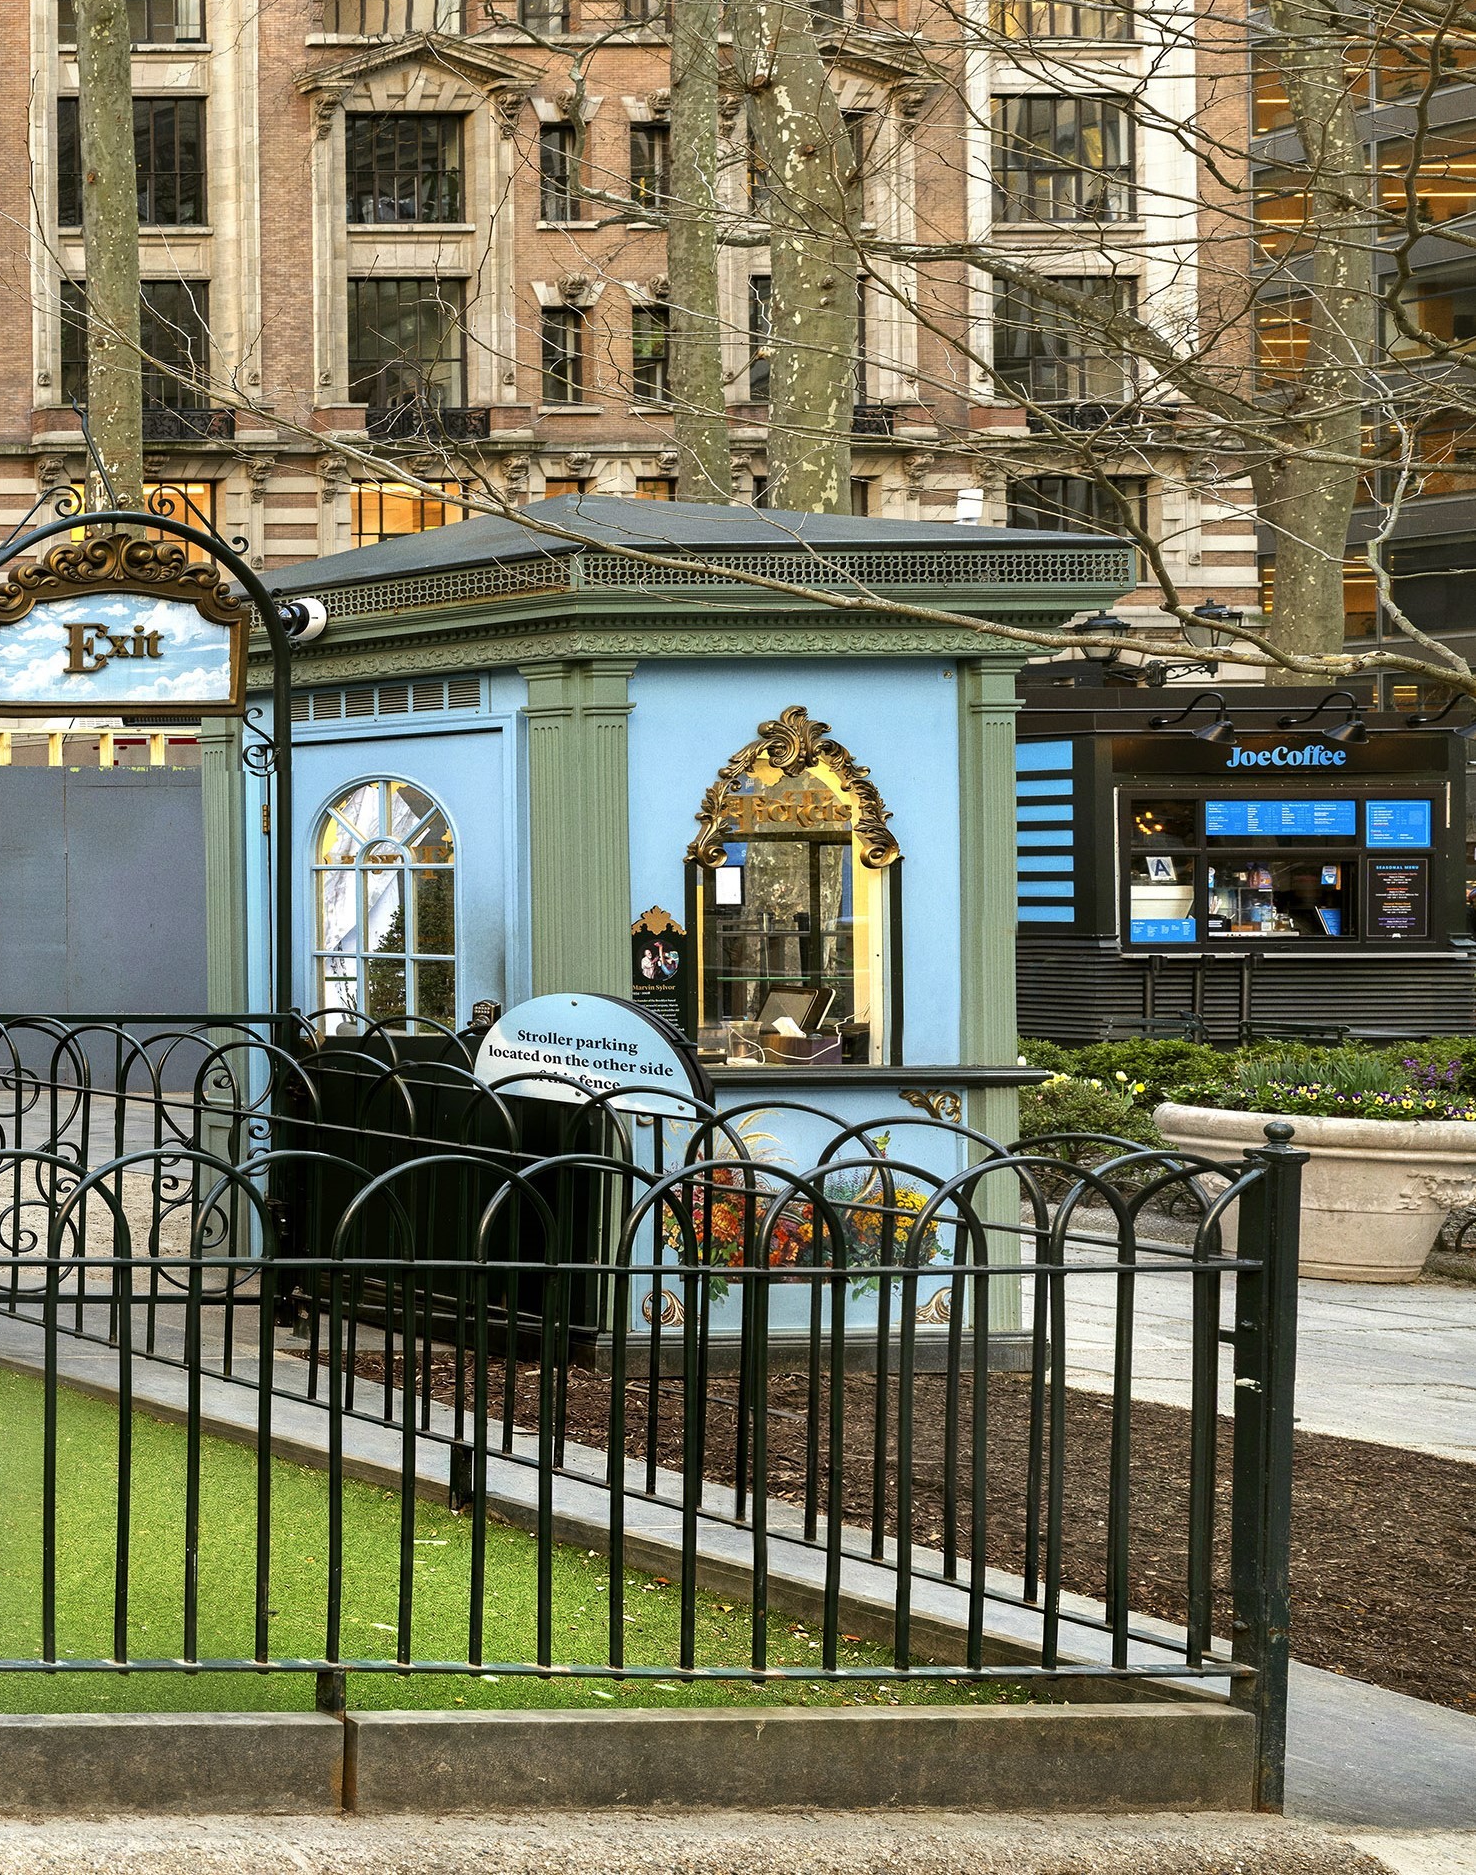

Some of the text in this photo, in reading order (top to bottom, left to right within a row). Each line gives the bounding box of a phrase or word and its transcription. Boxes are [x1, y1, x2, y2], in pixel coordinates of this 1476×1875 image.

[63, 623, 164, 673] Exit
[1226, 744, 1346, 767] JoeCoffee
[1154, 859, 1171, 876] A
[517, 1029, 638, 1055] Stroller parking
[489, 1045, 674, 1077] located on the other side
[579, 1074, 621, 1090] fence
